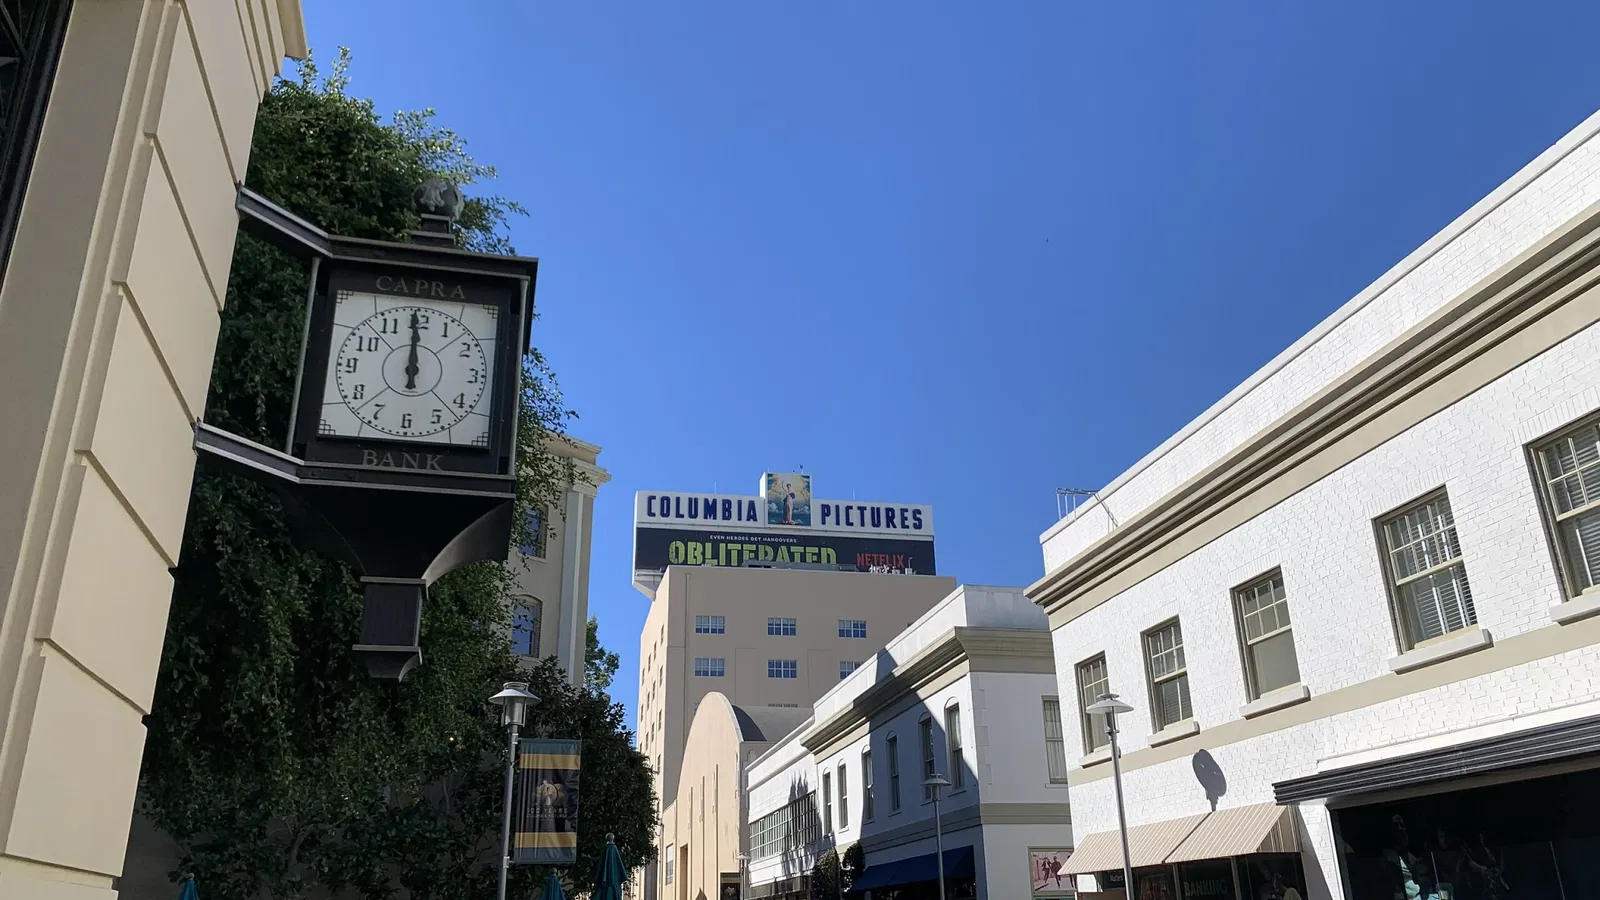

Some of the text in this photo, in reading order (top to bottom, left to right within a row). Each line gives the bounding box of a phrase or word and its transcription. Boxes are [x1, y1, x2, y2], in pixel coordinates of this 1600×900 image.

[375, 275, 466, 300] CAPRA
[379, 317, 398, 335] 11
[442, 322, 449, 338] 1
[355, 335, 380, 352] 10
[459, 342, 471, 358] 2
[345, 357, 359, 374] 9
[467, 368, 479, 384] 3
[352, 384, 365, 400] 8
[453, 392, 465, 409] 4
[373, 403, 386, 421] 7
[430, 409, 443, 425] 5
[400, 413, 412, 429] 6
[361, 449, 445, 471] BANK
[646, 495, 924, 530] COLUMBIA PICTURES
[668, 540, 837, 566] OBLITERATED
[856, 552, 905, 568] NETFLIX
[1183, 879, 1229, 896] BANKING
